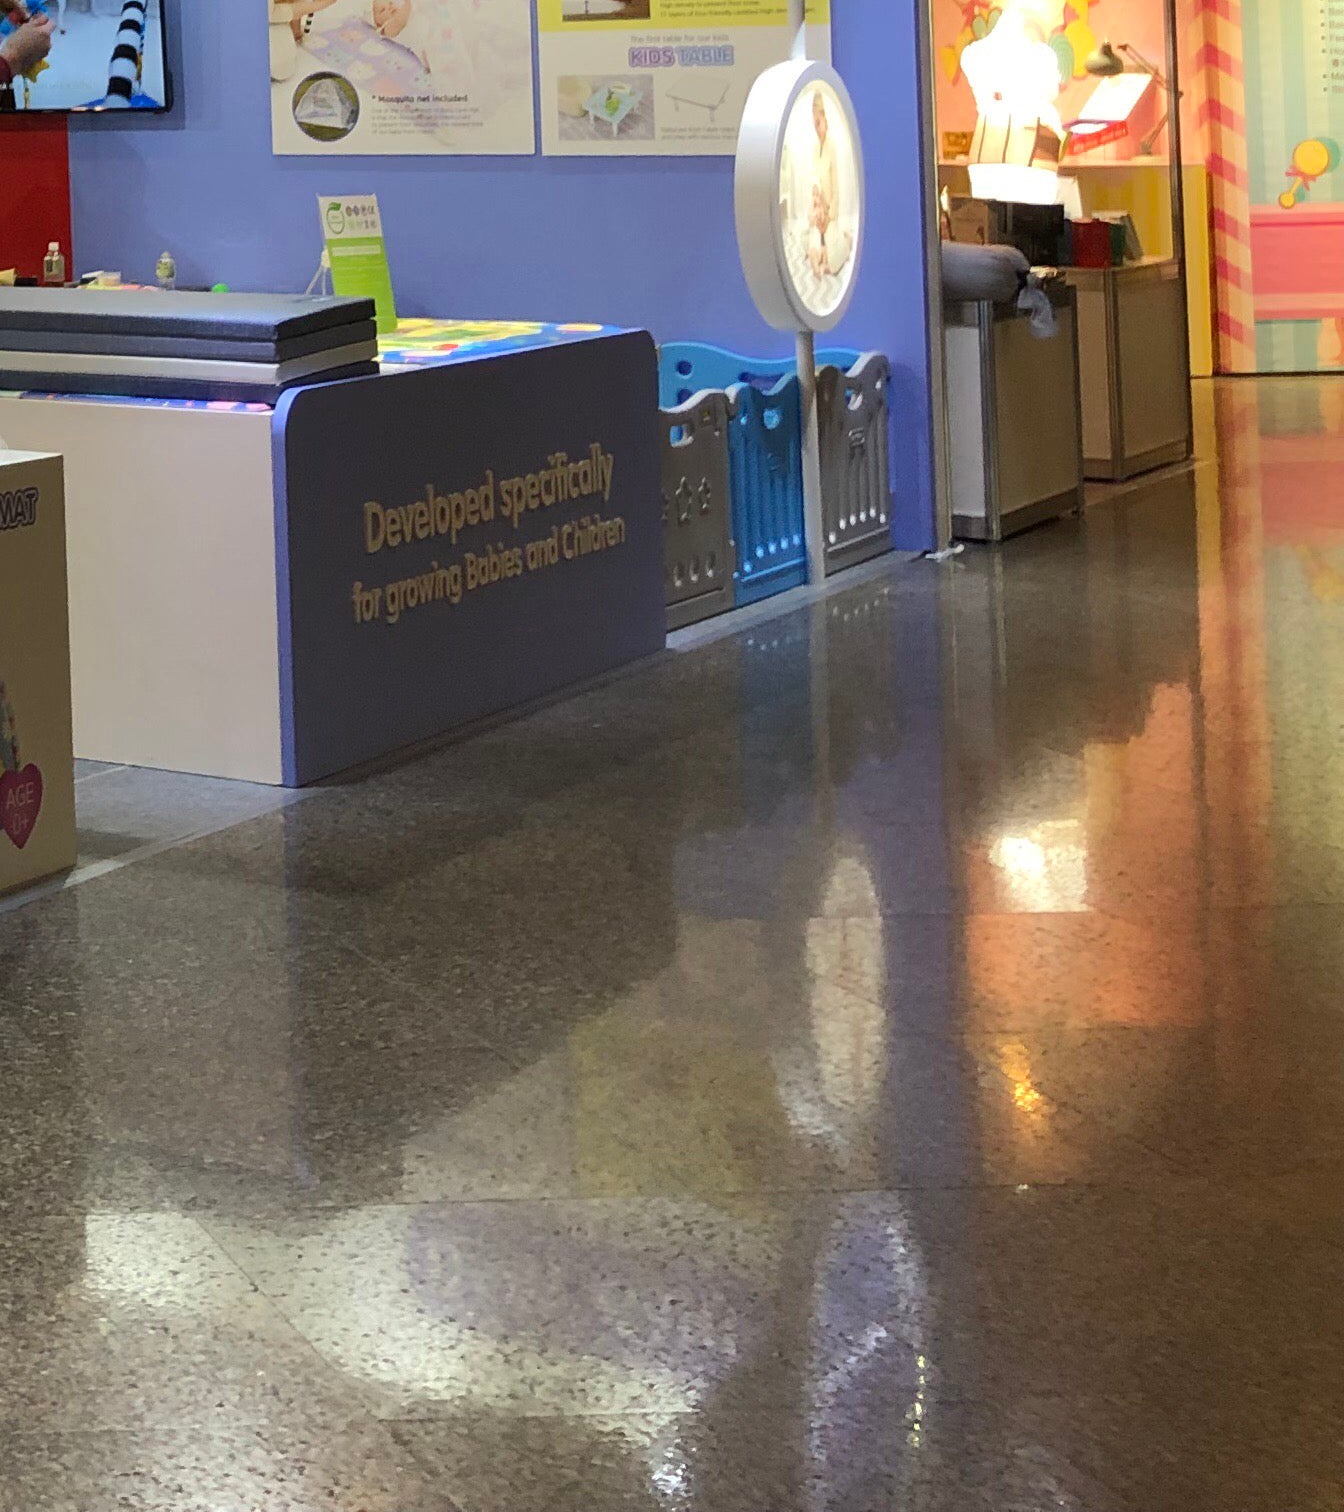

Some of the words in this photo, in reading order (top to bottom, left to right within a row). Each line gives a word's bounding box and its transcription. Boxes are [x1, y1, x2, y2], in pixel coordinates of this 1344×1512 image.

[629, 46, 675, 68] KIDS
[677, 45, 734, 67] TABLE
[432, 94, 468, 103] included
[363, 469, 495, 554] Developed
[499, 442, 613, 529] specifically
[352, 581, 381, 623] for
[385, 560, 462, 624] growing
[464, 542, 522, 590] Babies
[525, 525, 559, 571] and
[562, 513, 625, 560] Children
[7, 782, 34, 808] AGE
